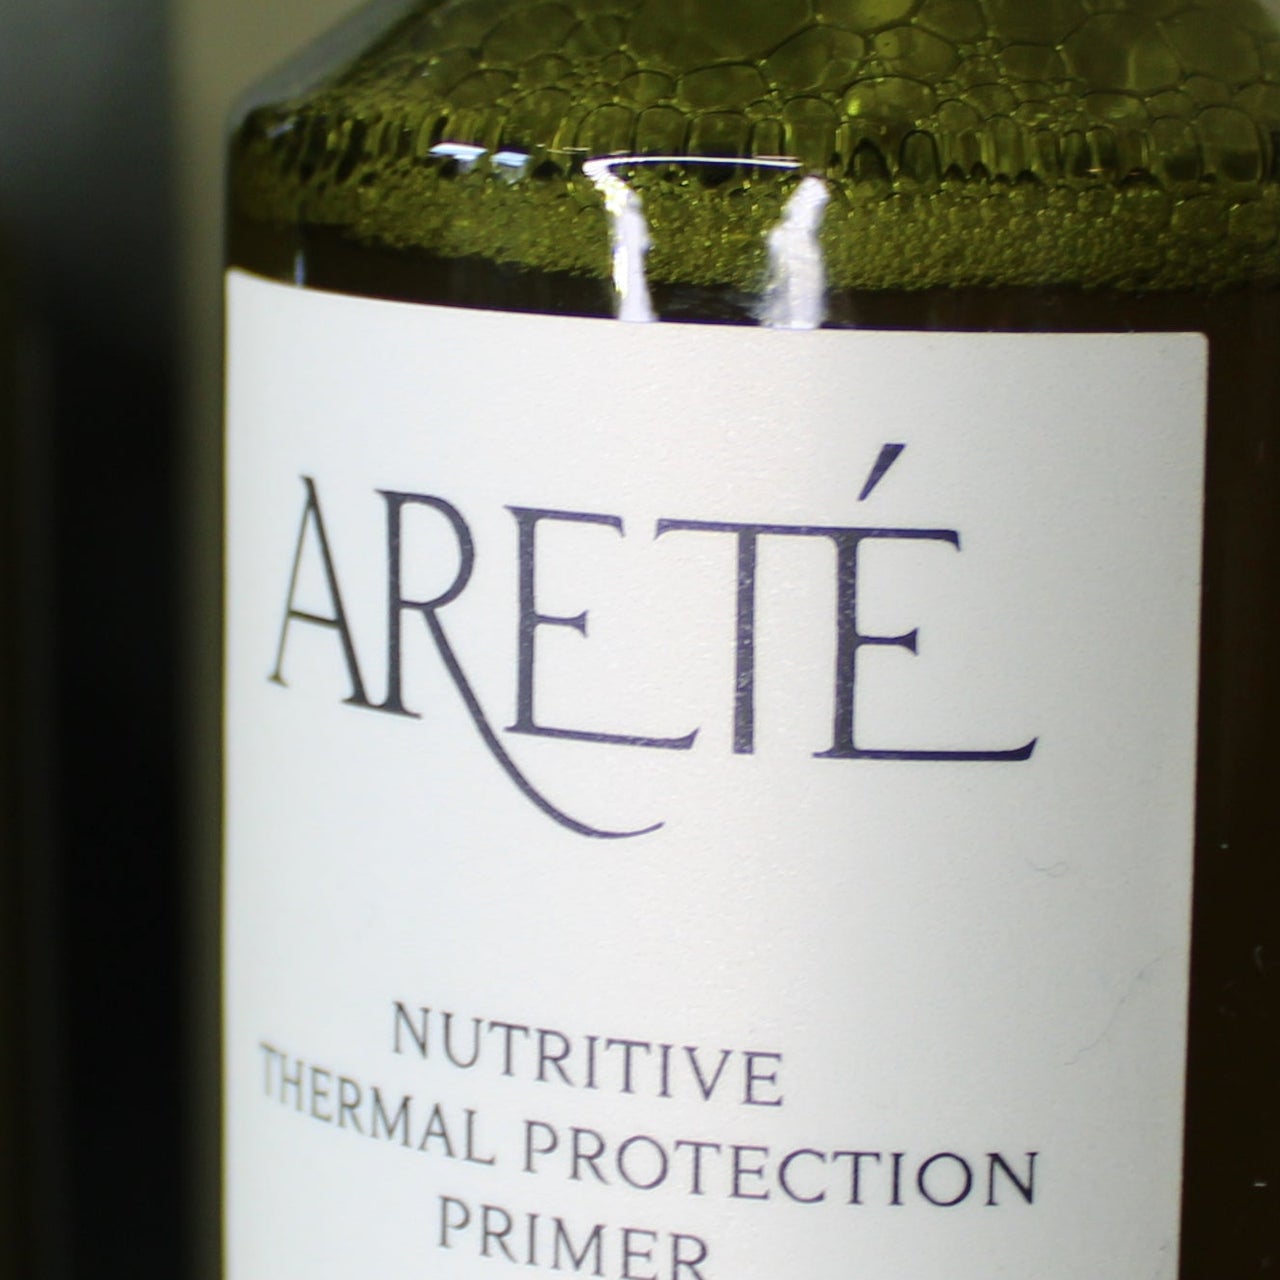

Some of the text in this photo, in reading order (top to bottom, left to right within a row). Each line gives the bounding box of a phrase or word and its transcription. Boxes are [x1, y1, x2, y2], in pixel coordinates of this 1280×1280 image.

[267, 441, 1038, 840] ARETÉ
[258, 1041, 1042, 1208] THERMAL PROTECTION
[391, 1000, 786, 1108] NUTRITIVE
